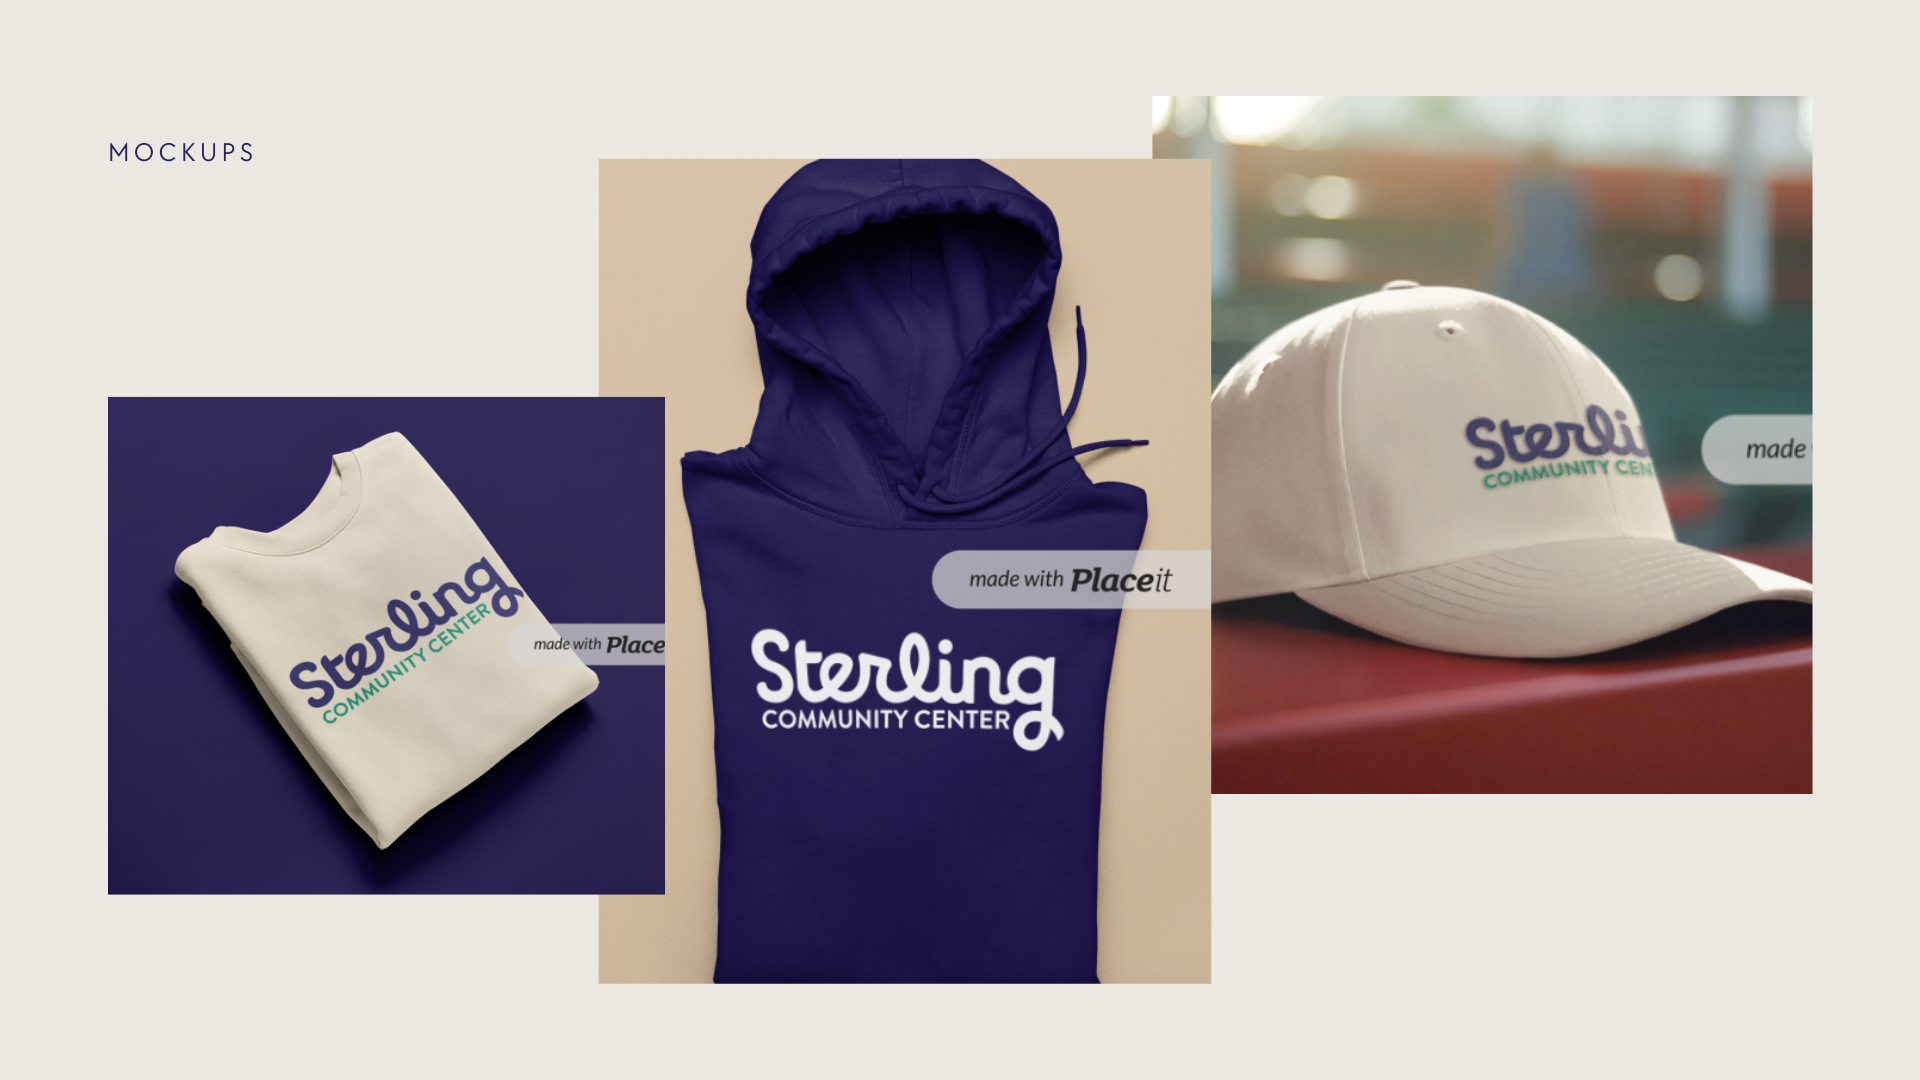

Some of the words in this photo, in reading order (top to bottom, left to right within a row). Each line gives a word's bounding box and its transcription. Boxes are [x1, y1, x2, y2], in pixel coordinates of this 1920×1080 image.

[109, 142, 253, 163] MOCKUPS
[1483, 458, 1610, 490] COMMUNITY
[288, 556, 525, 709] Sterling
[321, 647, 429, 725] COMMUNITY
[427, 602, 492, 655] CENTER
[750, 628, 1065, 752] Sterling
[762, 709, 909, 730] COMMUNITY
[914, 709, 1011, 730] CENTER
